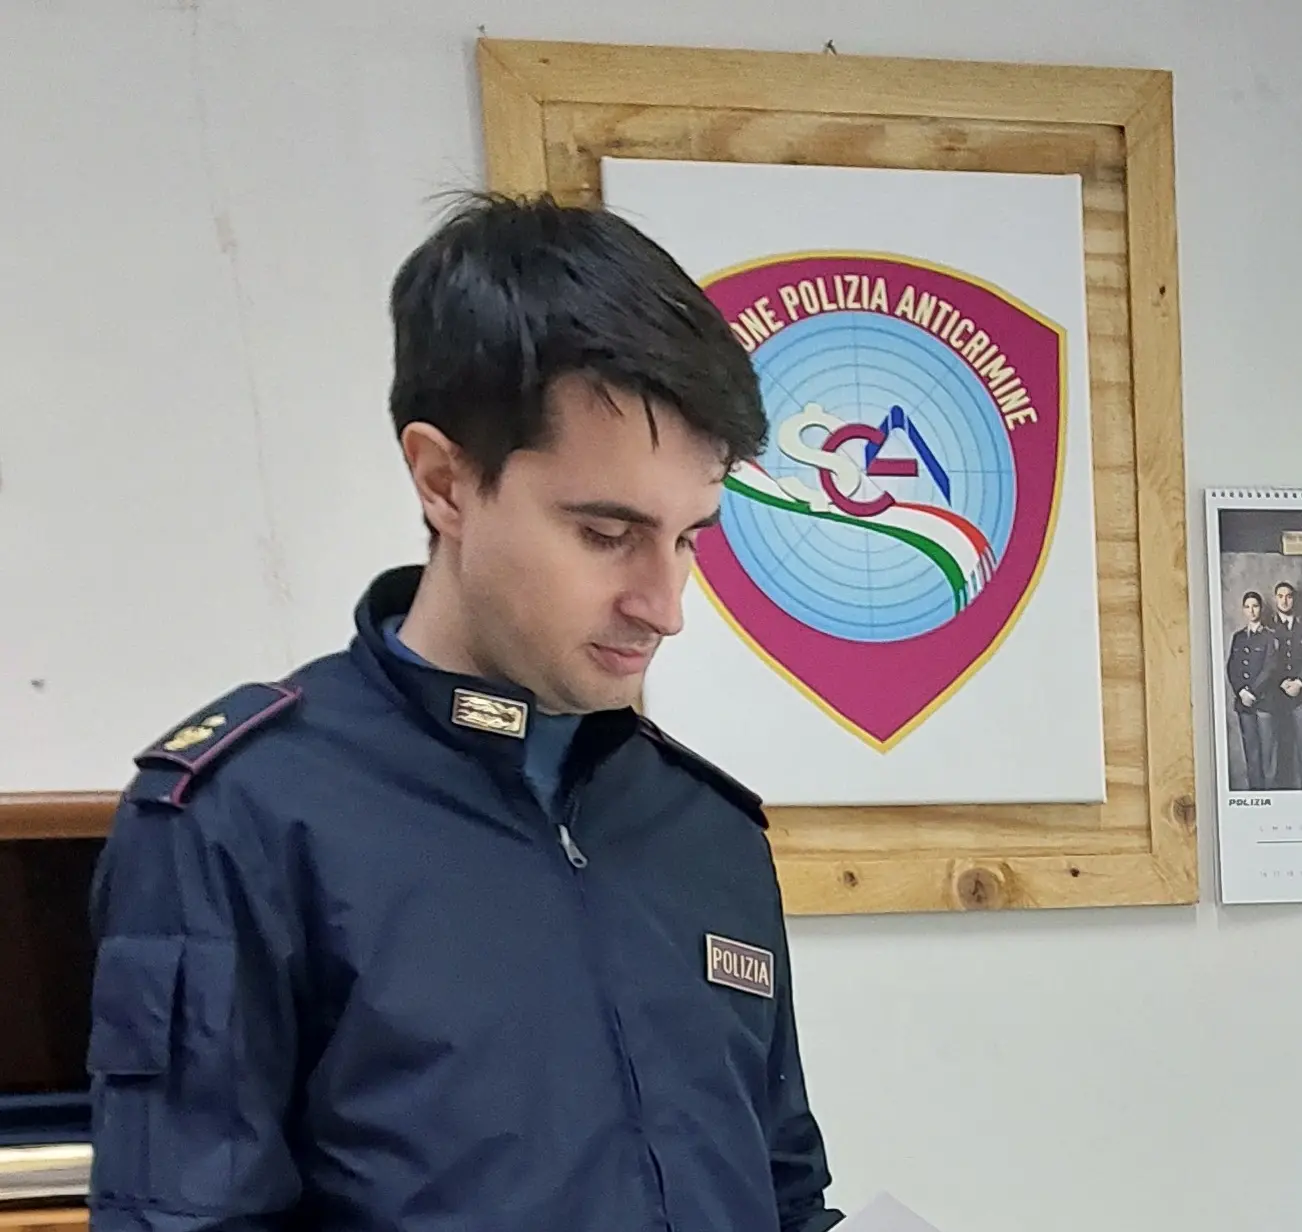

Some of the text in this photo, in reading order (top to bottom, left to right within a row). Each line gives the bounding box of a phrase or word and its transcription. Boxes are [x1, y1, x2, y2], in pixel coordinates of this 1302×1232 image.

[729, 274, 1038, 431] ONE POLIZIA ANTICRIMINE
[1228, 798, 1272, 806] POLIZIA
[712, 946, 769, 986] POLIZIA
